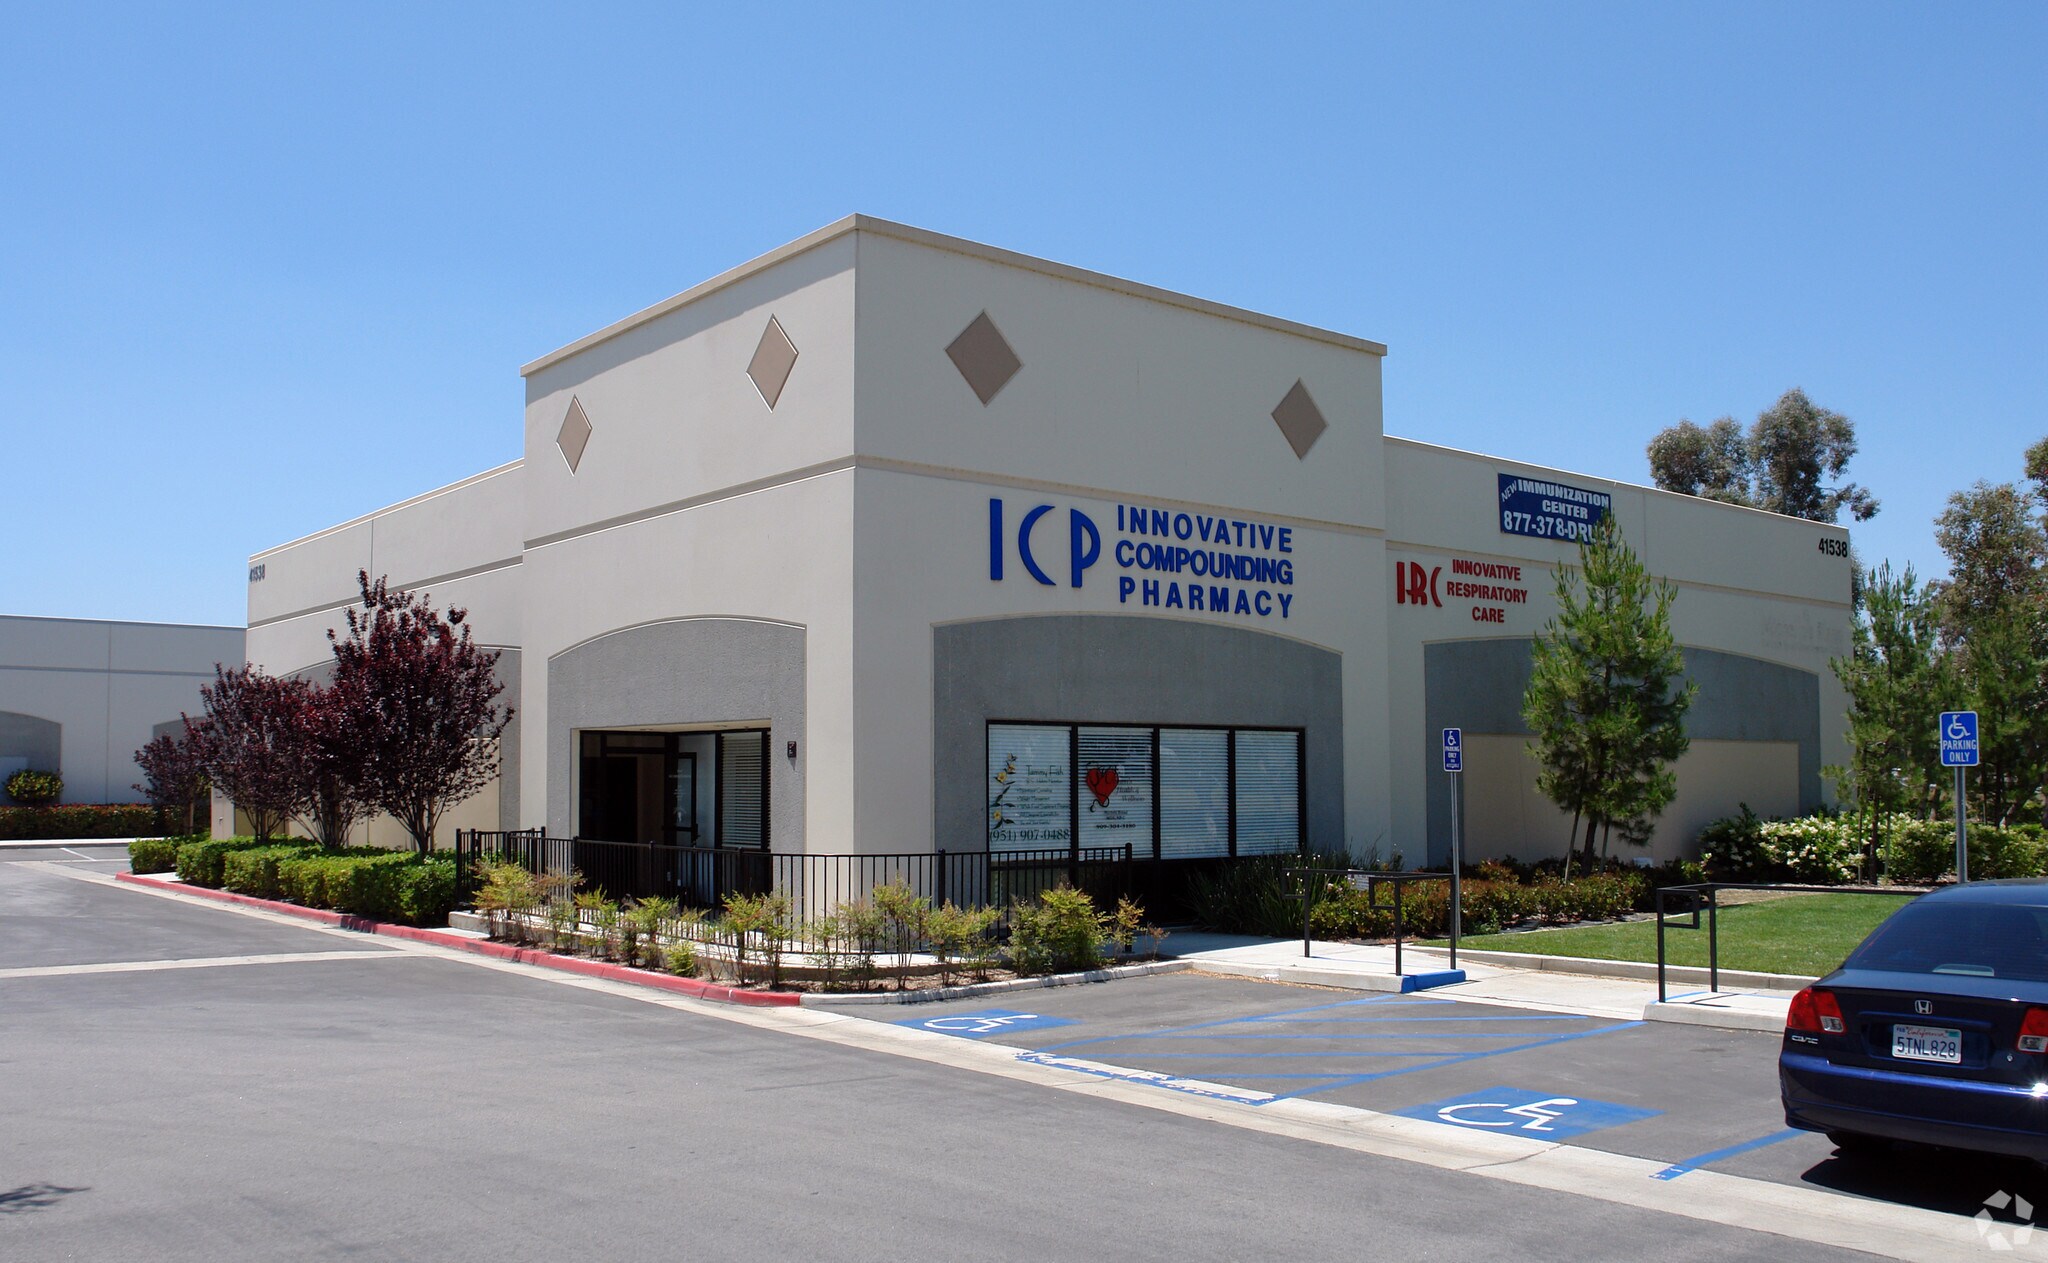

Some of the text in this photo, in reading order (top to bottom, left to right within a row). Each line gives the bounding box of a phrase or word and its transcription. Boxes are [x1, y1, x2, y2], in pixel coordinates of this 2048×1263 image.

[1501, 479, 1609, 508] NEW IMMUNIZATION
[1542, 500, 1588, 519] CENTER
[1117, 504, 1293, 553] INNOVATIVE
[989, 498, 1101, 588] ICP
[1818, 538, 1848, 558] 41538
[1115, 540, 1294, 585] COMPOUNDING
[1452, 559, 1522, 581] INNOVATIVE
[1119, 576, 1293, 618] PHARMACY
[1447, 581, 1528, 604] RESPIRATORY
[1472, 606, 1505, 623] CARE
[1942, 739, 1977, 750] PARKING
[1949, 751, 1971, 762] ONLY
[989, 830, 1016, 842] (951)
[1897, 1036, 1957, 1059] 5TNL828
